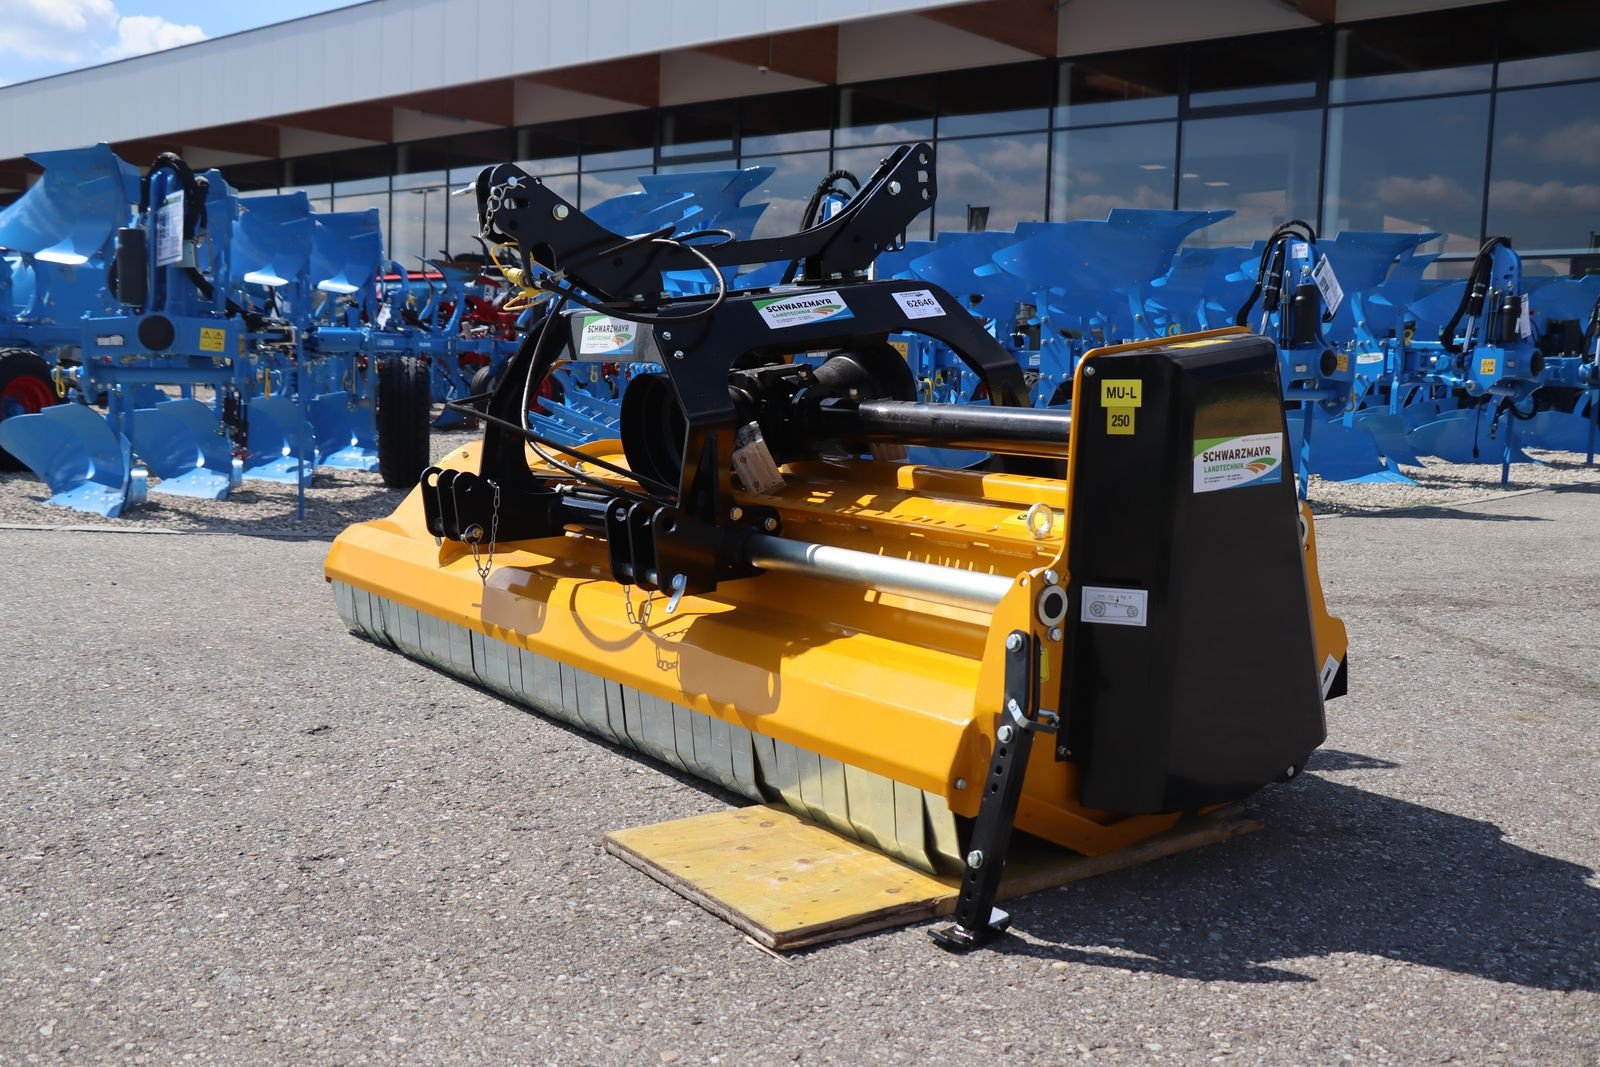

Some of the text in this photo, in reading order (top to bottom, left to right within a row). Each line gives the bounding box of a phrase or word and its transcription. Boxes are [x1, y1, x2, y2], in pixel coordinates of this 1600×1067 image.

[765, 298, 833, 313] SCHWARZMAYR
[906, 298, 935, 308] 62646
[772, 309, 812, 318] LANDTECHNIK
[587, 324, 630, 333] SCHWARZMAYR
[1106, 386, 1137, 399] MU-L
[1111, 414, 1130, 427] 250
[1202, 445, 1271, 463] SCHWARZMAYR
[1203, 463, 1244, 474] LANDTECHNIK
